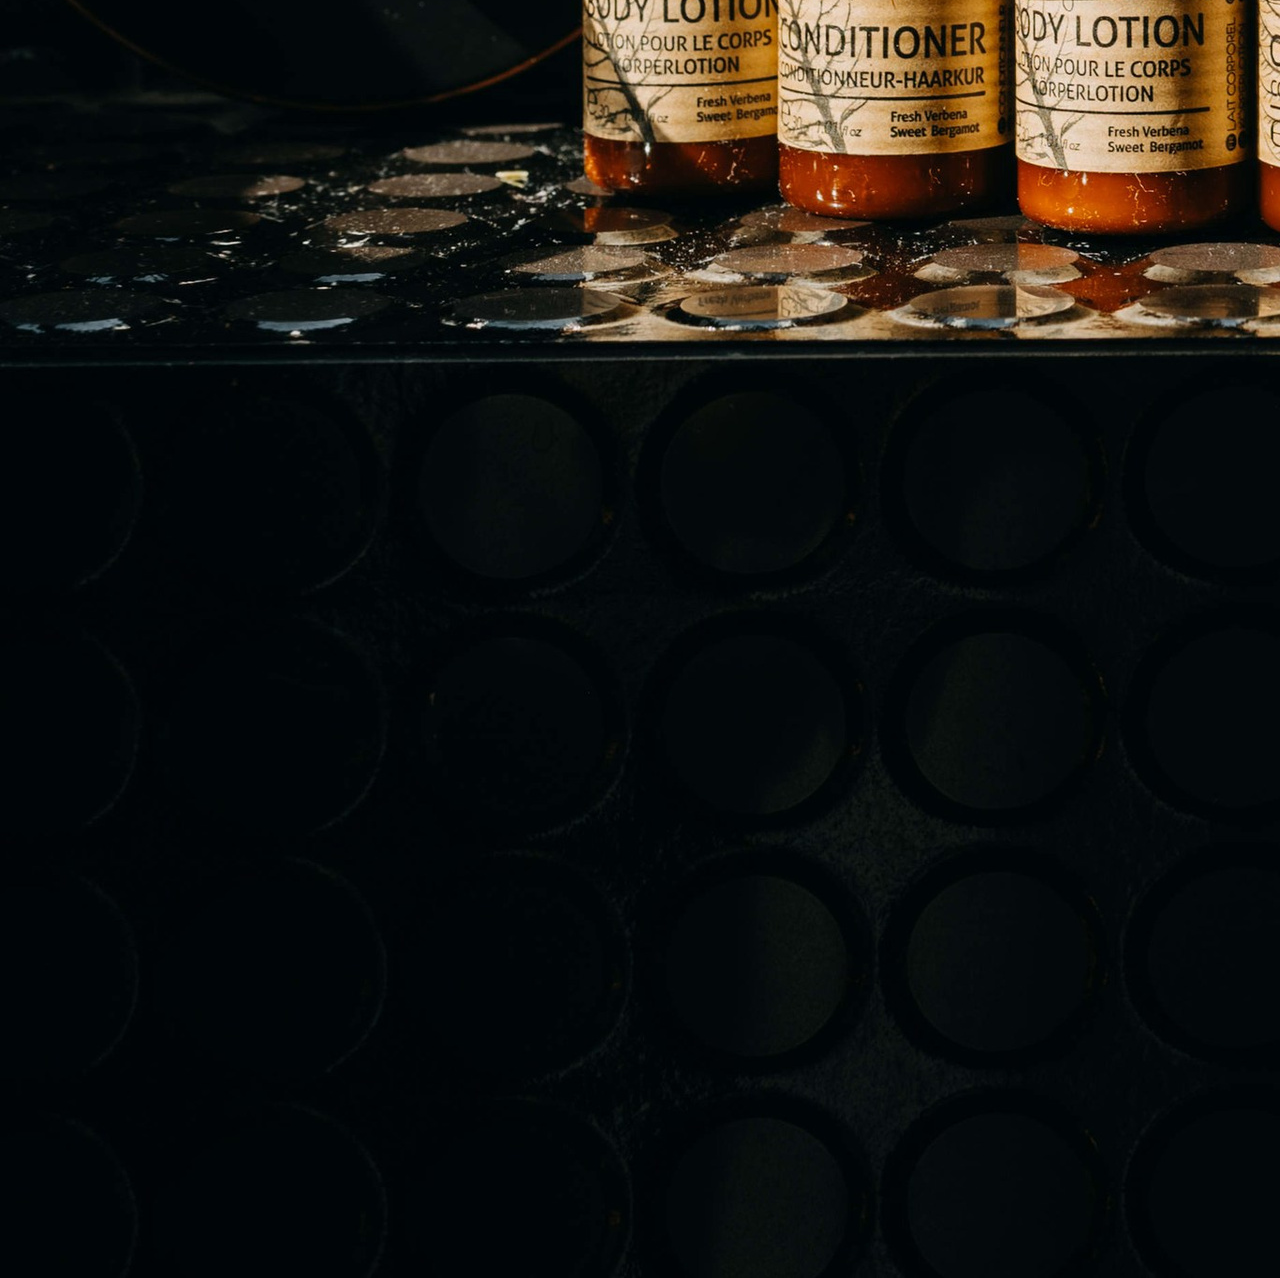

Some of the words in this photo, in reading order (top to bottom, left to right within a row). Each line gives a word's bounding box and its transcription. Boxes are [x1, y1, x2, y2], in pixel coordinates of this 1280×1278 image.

[780, 17, 987, 59] CONDITIONER
[1016, 7, 1065, 44] ODY
[1075, 12, 1206, 48] LOTION
[640, 35, 687, 52] POUR
[693, 35, 713, 52] LE
[717, 29, 772, 51] CORPS
[614, 53, 740, 75] KÖRPERLOTION
[1055, 56, 1099, 77] POUR
[1105, 60, 1125, 78] LE
[1130, 58, 1192, 78] CORPS
[1226, 16, 1237, 96] CORPOREL
[780, 61, 985, 89] CONDITIONNEUR-HAARKUR
[696, 95, 727, 109] Fresh
[729, 92, 771, 107] Verbena
[1032, 78, 1154, 102] KÖRPERLOTION
[696, 110, 731, 124] Sweet
[737, 105, 778, 123] Bergamo
[890, 110, 921, 123] Fresh
[924, 108, 968, 123] Verbena
[1226, 100, 1237, 131] LAIT
[890, 126, 926, 138] Sweet
[931, 122, 980, 139] Bergamot
[1107, 126, 1139, 138] Fresh
[1142, 126, 1190, 138] Verbena
[1107, 141, 1144, 153] Sweet
[1150, 139, 1204, 155] Bergamot
